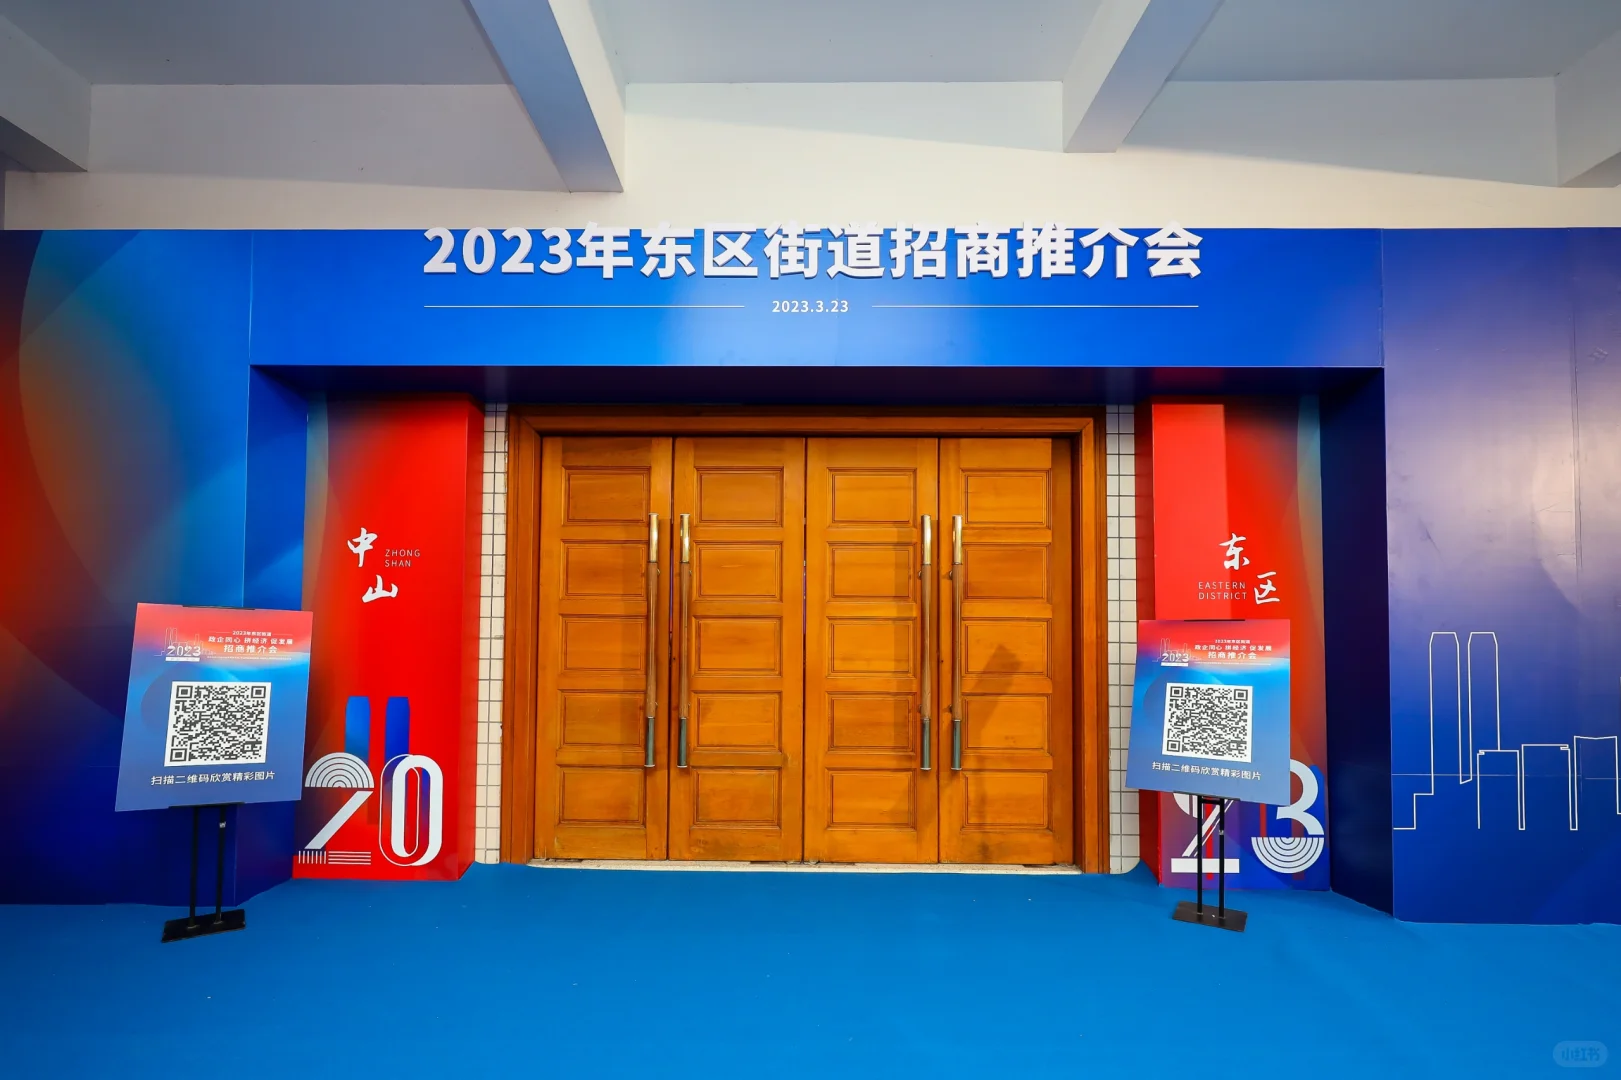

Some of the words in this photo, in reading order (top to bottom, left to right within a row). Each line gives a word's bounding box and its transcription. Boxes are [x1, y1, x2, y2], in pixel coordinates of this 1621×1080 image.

[423, 221, 1204, 279] 2023年东区街道招商推介会
[772, 300, 850, 314] 2023.3.23
[384, 548, 421, 558] ZHONG
[384, 559, 411, 568] SHAN
[1197, 581, 1246, 590] EASTERN
[1197, 591, 1247, 600] DISTRICT
[167, 645, 201, 657] 2023
[223, 644, 278, 654] 招商推介会
[1161, 652, 1190, 663] 2023
[1208, 651, 1257, 660] 招商推介会
[1151, 761, 1262, 781] 扫描二维码欣赏精彩图片
[151, 770, 276, 787] 扫描二维码欣赏精彩图片
